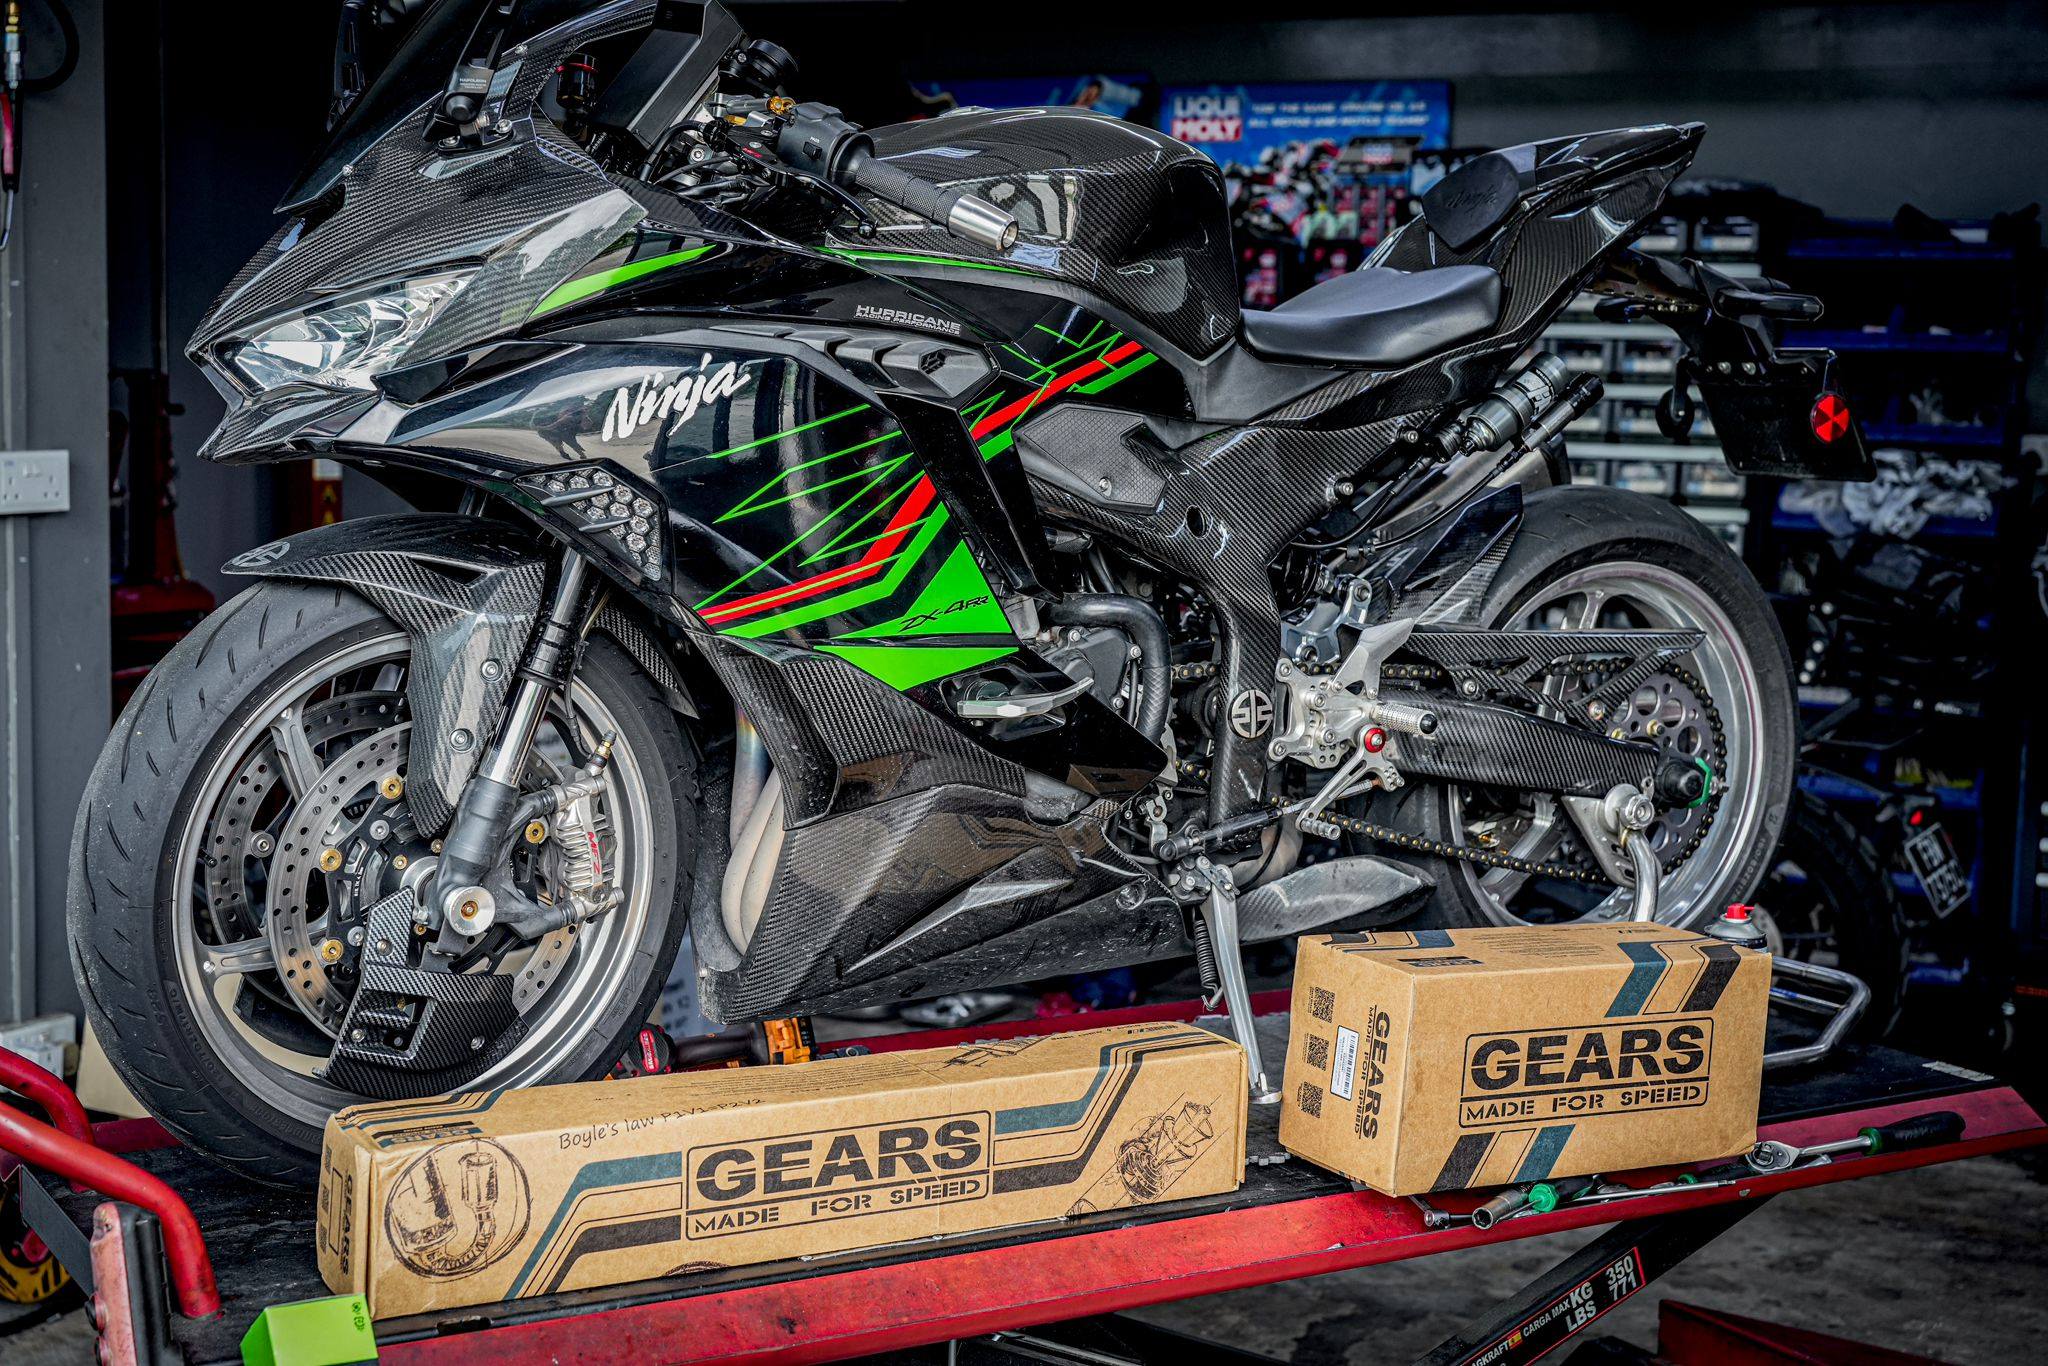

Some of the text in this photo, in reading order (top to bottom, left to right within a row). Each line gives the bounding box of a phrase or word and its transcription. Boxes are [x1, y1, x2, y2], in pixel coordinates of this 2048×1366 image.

[1173, 95, 1241, 117] LIQUI
[1172, 118, 1242, 141] MOLY
[854, 312, 891, 321] RACING
[856, 304, 961, 332] HURRICANE
[602, 352, 751, 442] Ninja
[1360, 1052, 1370, 1081] FOR
[1362, 1011, 1390, 1140] GEARS
[1471, 1025, 1704, 1090] GEARS
[1466, 1085, 1701, 1121] MADE FOR SPEED
[559, 1122, 618, 1149] Boyle's
[624, 1117, 654, 1133] law
[696, 1119, 981, 1201] GEARS
[695, 1179, 981, 1233] MADE FOR SPEED
[1605, 1255, 1634, 1285] 350
[1522, 1314, 1551, 1338] CARGA
[1551, 1298, 1571, 1317] MAX
[1569, 1282, 1594, 1309] KG
[1565, 1272, 1637, 1333] LBS 771
